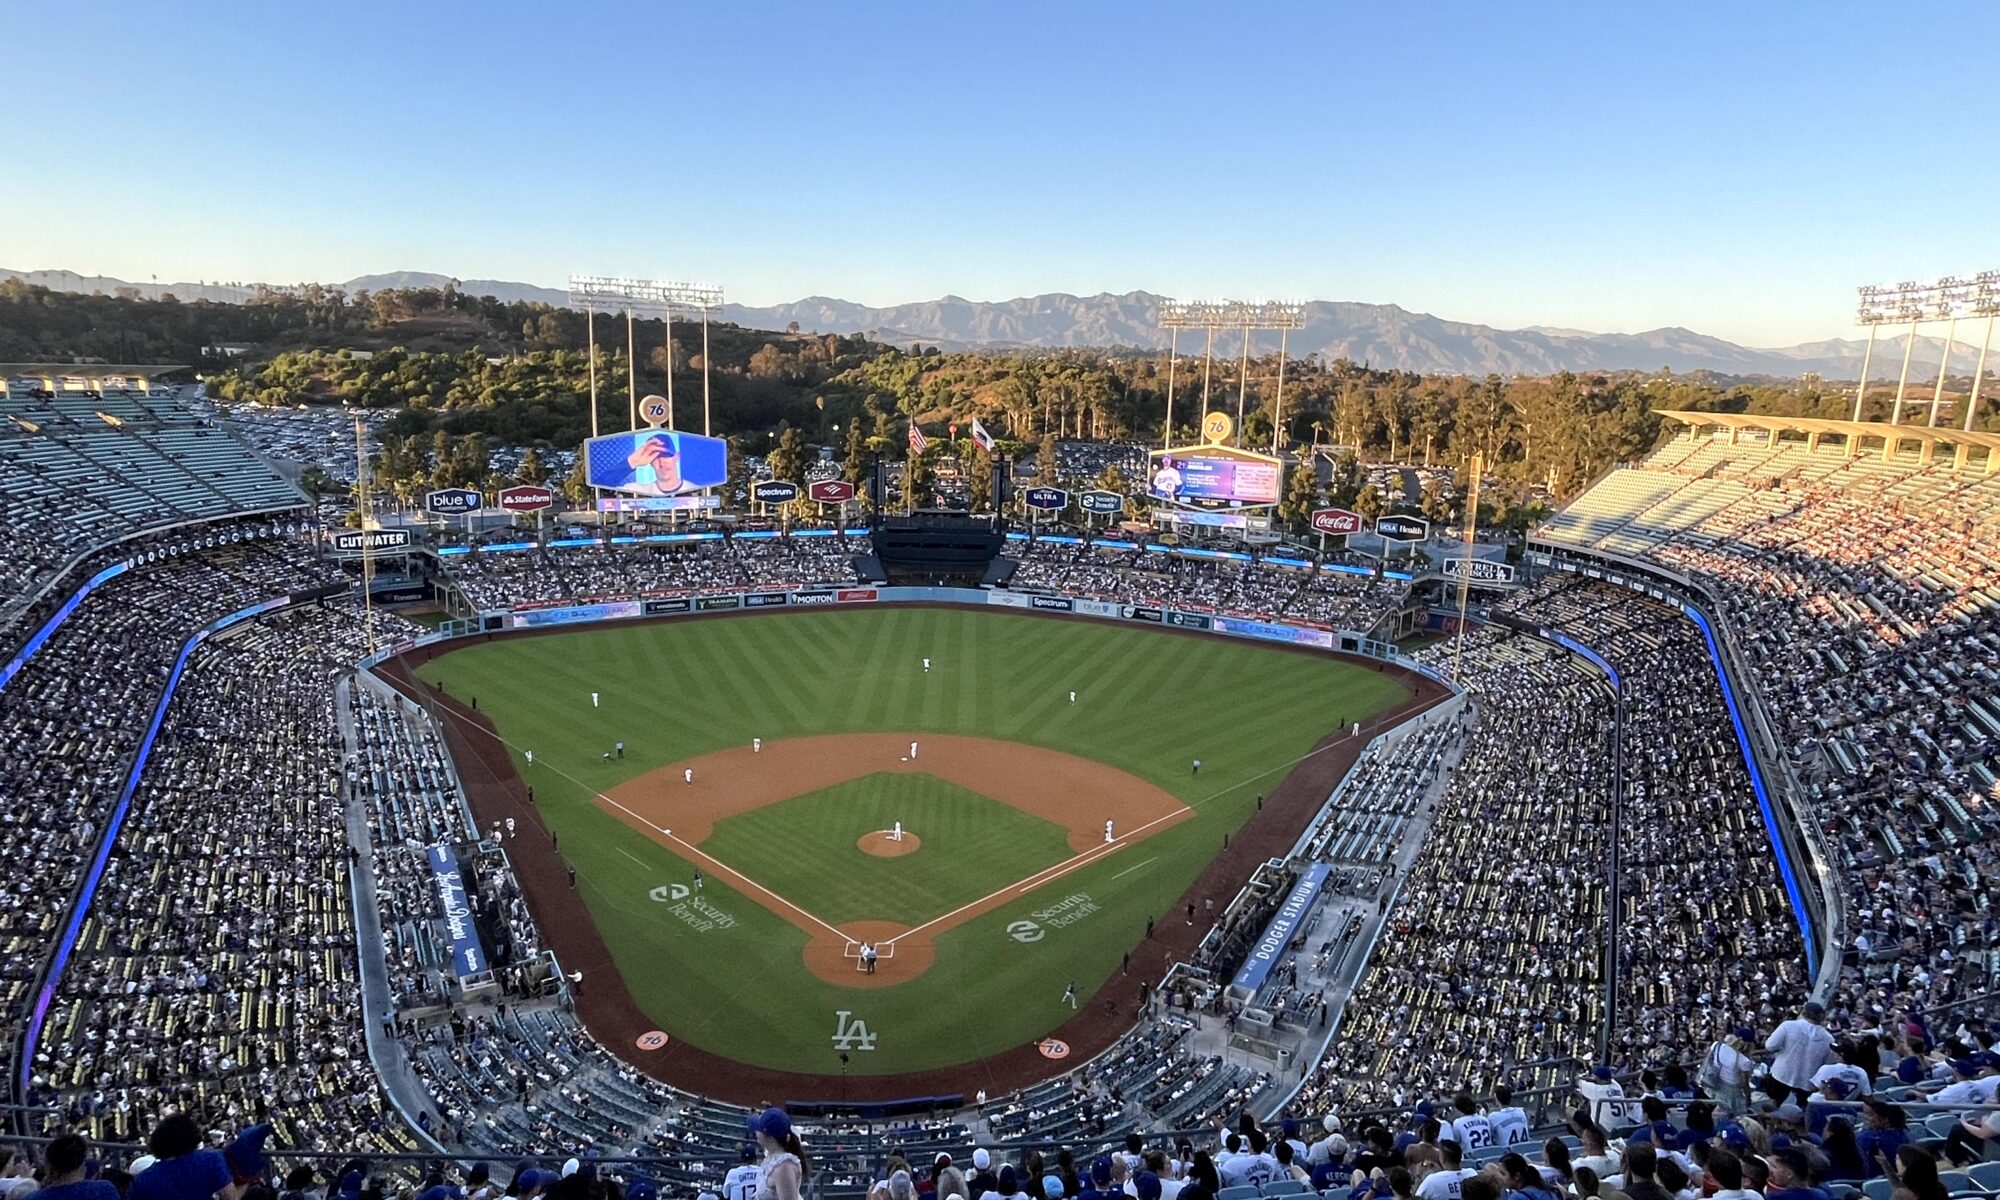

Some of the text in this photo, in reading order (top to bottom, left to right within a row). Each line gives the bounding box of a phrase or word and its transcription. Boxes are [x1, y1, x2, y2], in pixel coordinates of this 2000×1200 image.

[650, 404, 664, 416] 76
[1209, 421, 1224, 433] 76
[757, 488, 792, 496] Spectrum
[433, 494, 464, 507] blue
[1095, 495, 1118, 504] Security
[1380, 523, 1423, 534] UCLA Health
[340, 533, 405, 548] CUTWATER
[798, 595, 833, 604] MORTON
[1034, 597, 1069, 608] Spectrum
[686, 896, 739, 929] Security
[1030, 891, 1092, 920] Security
[666, 903, 714, 933] Benefit
[1046, 902, 1102, 929] Benefit
[1256, 881, 1316, 960] DODGER STADIUM
[447, 907, 470, 940] Dodgers
[831, 1010, 877, 1050] LA
[643, 1035, 662, 1045] 76
[1046, 1044, 1064, 1054] 76
[1469, 1128, 1491, 1149] 22
[1509, 1127, 1529, 1145] 44
